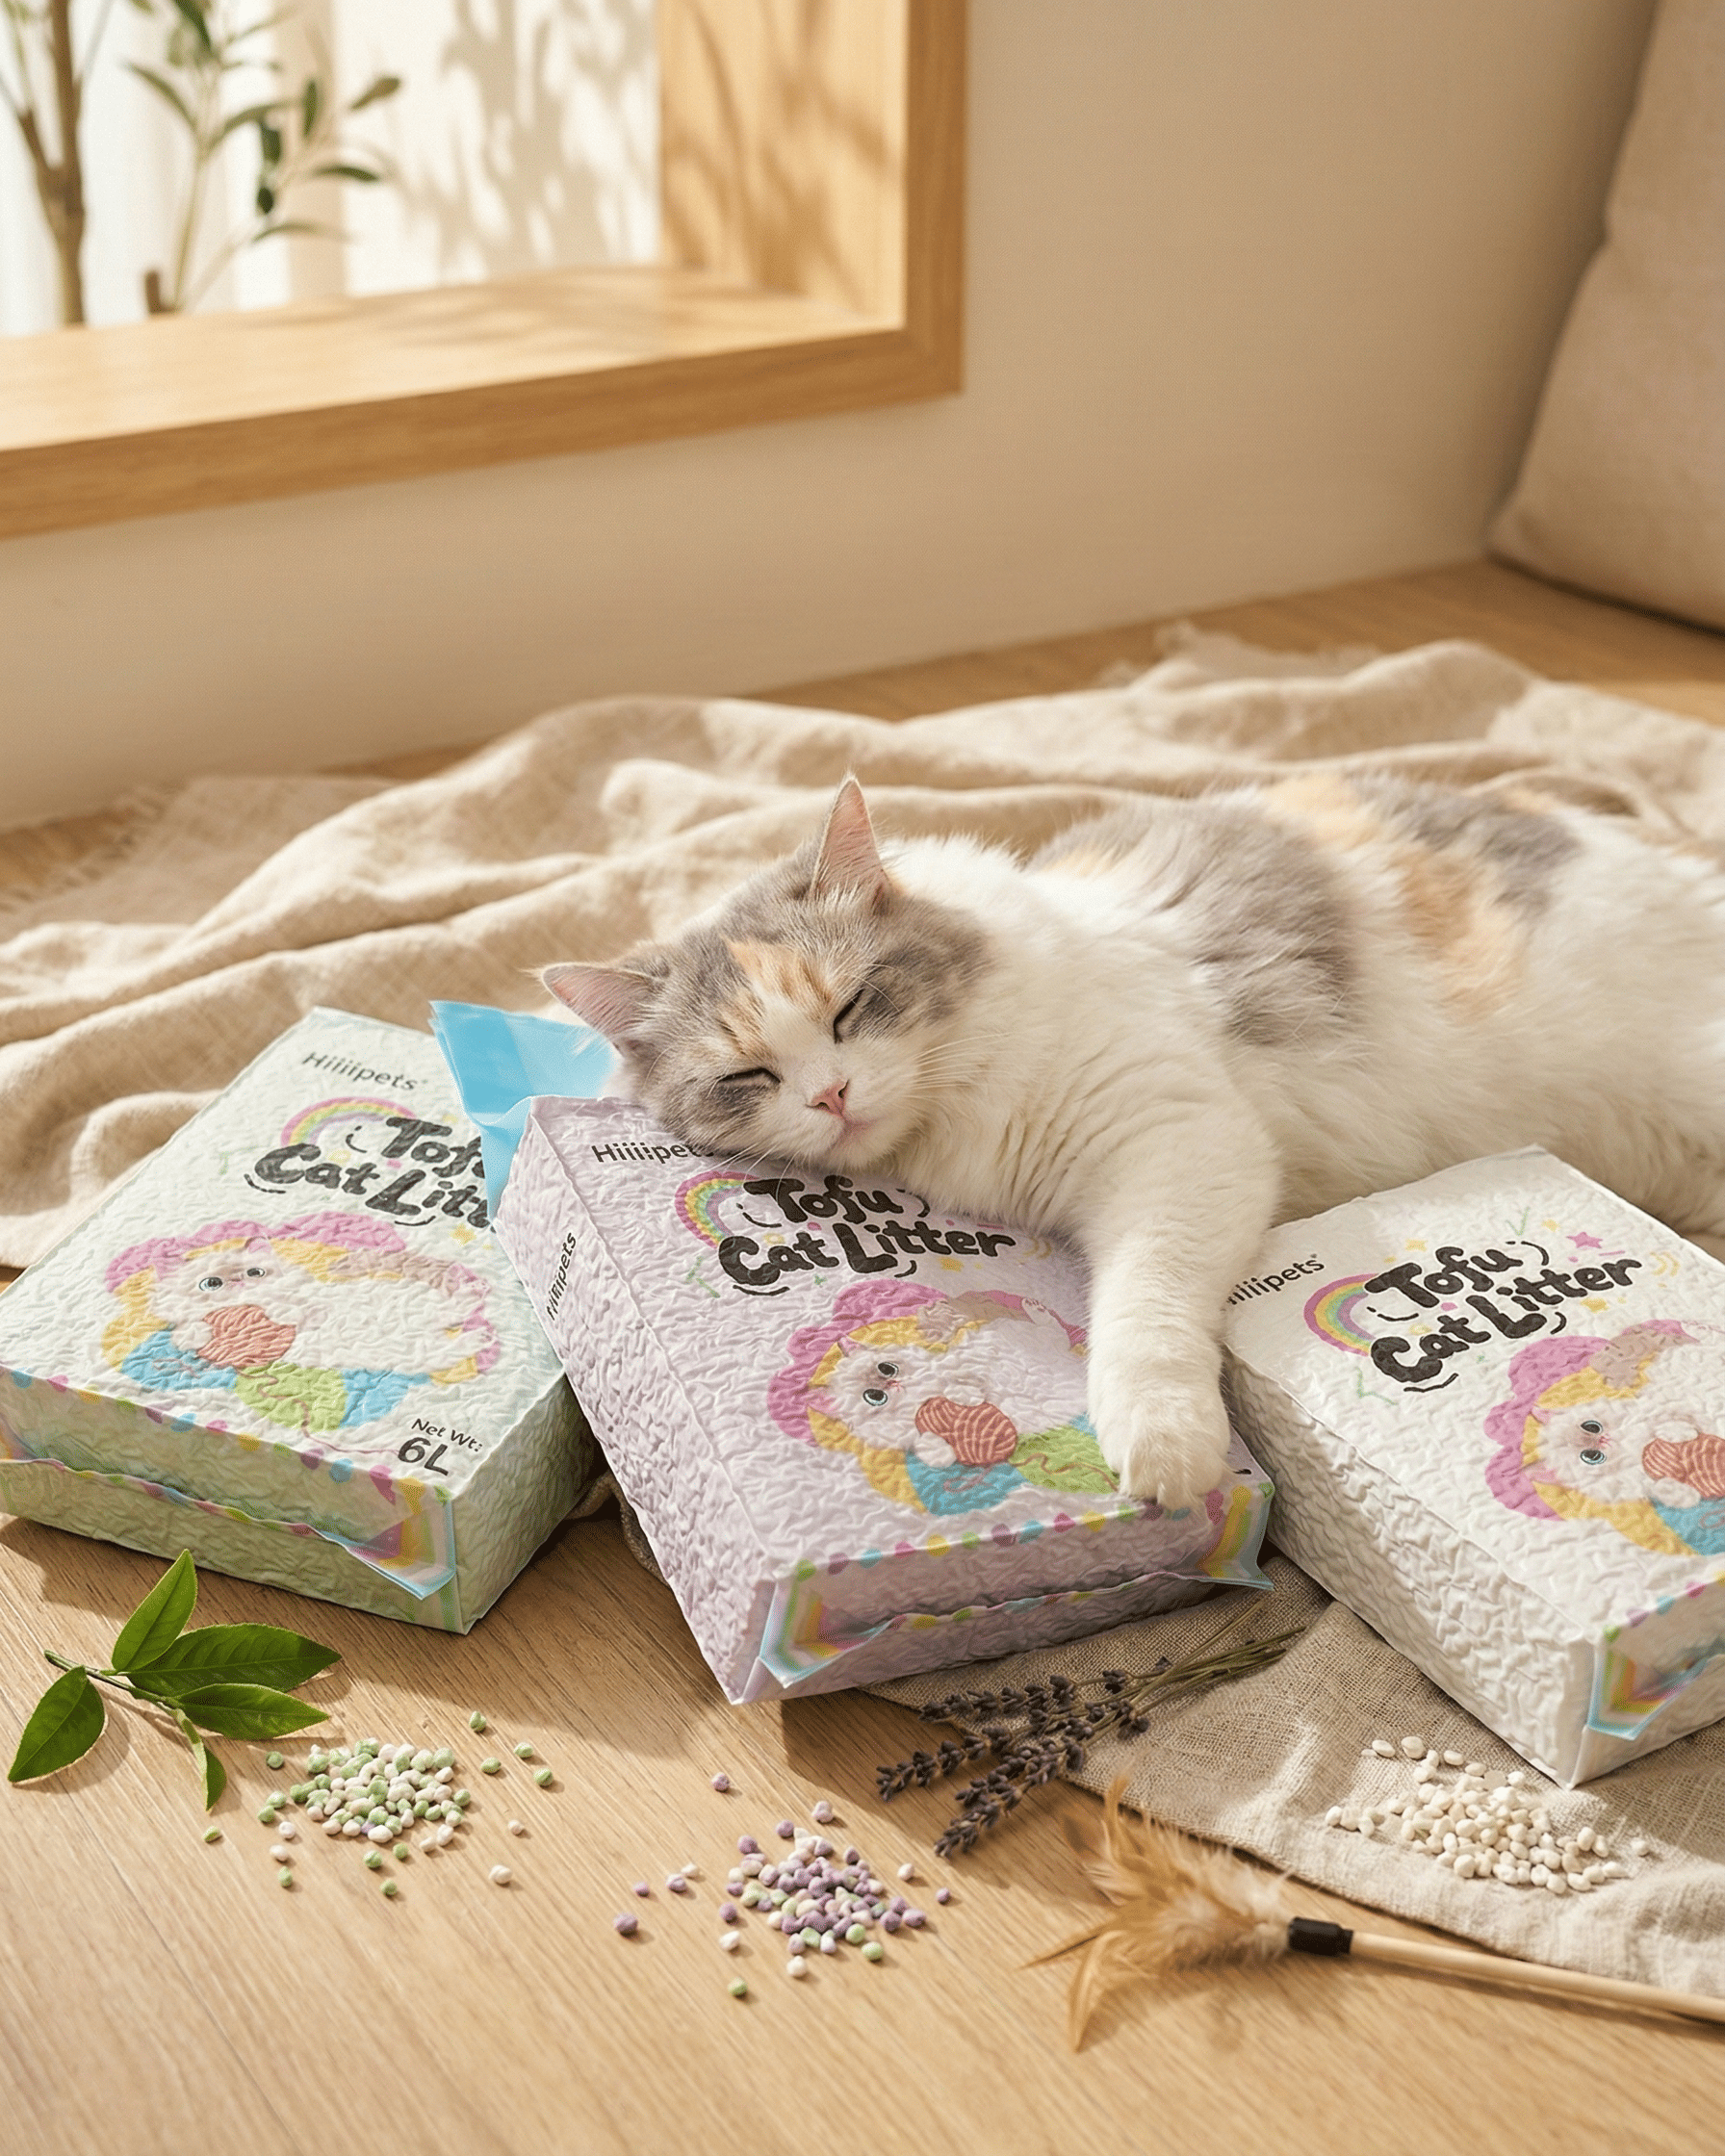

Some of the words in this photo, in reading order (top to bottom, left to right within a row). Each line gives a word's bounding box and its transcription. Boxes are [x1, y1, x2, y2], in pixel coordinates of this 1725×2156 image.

[301, 1051, 418, 1091] Hiiiipets
[381, 1116, 485, 1179] Tof
[254, 1142, 380, 1194] Cat
[365, 1169, 491, 1229] Litt
[743, 1174, 905, 1225] Tofu
[718, 1232, 839, 1286] Cat
[832, 1215, 1017, 1274] Litter
[1364, 1246, 1524, 1309] Tofu
[1228, 1259, 1325, 1305] iiiipets
[1371, 1314, 1492, 1383] Cat
[1465, 1258, 1643, 1340] Litter
[398, 1437, 450, 1476] 6L
[411, 1418, 446, 1437] Net
[450, 1429, 483, 1452] Wt:
